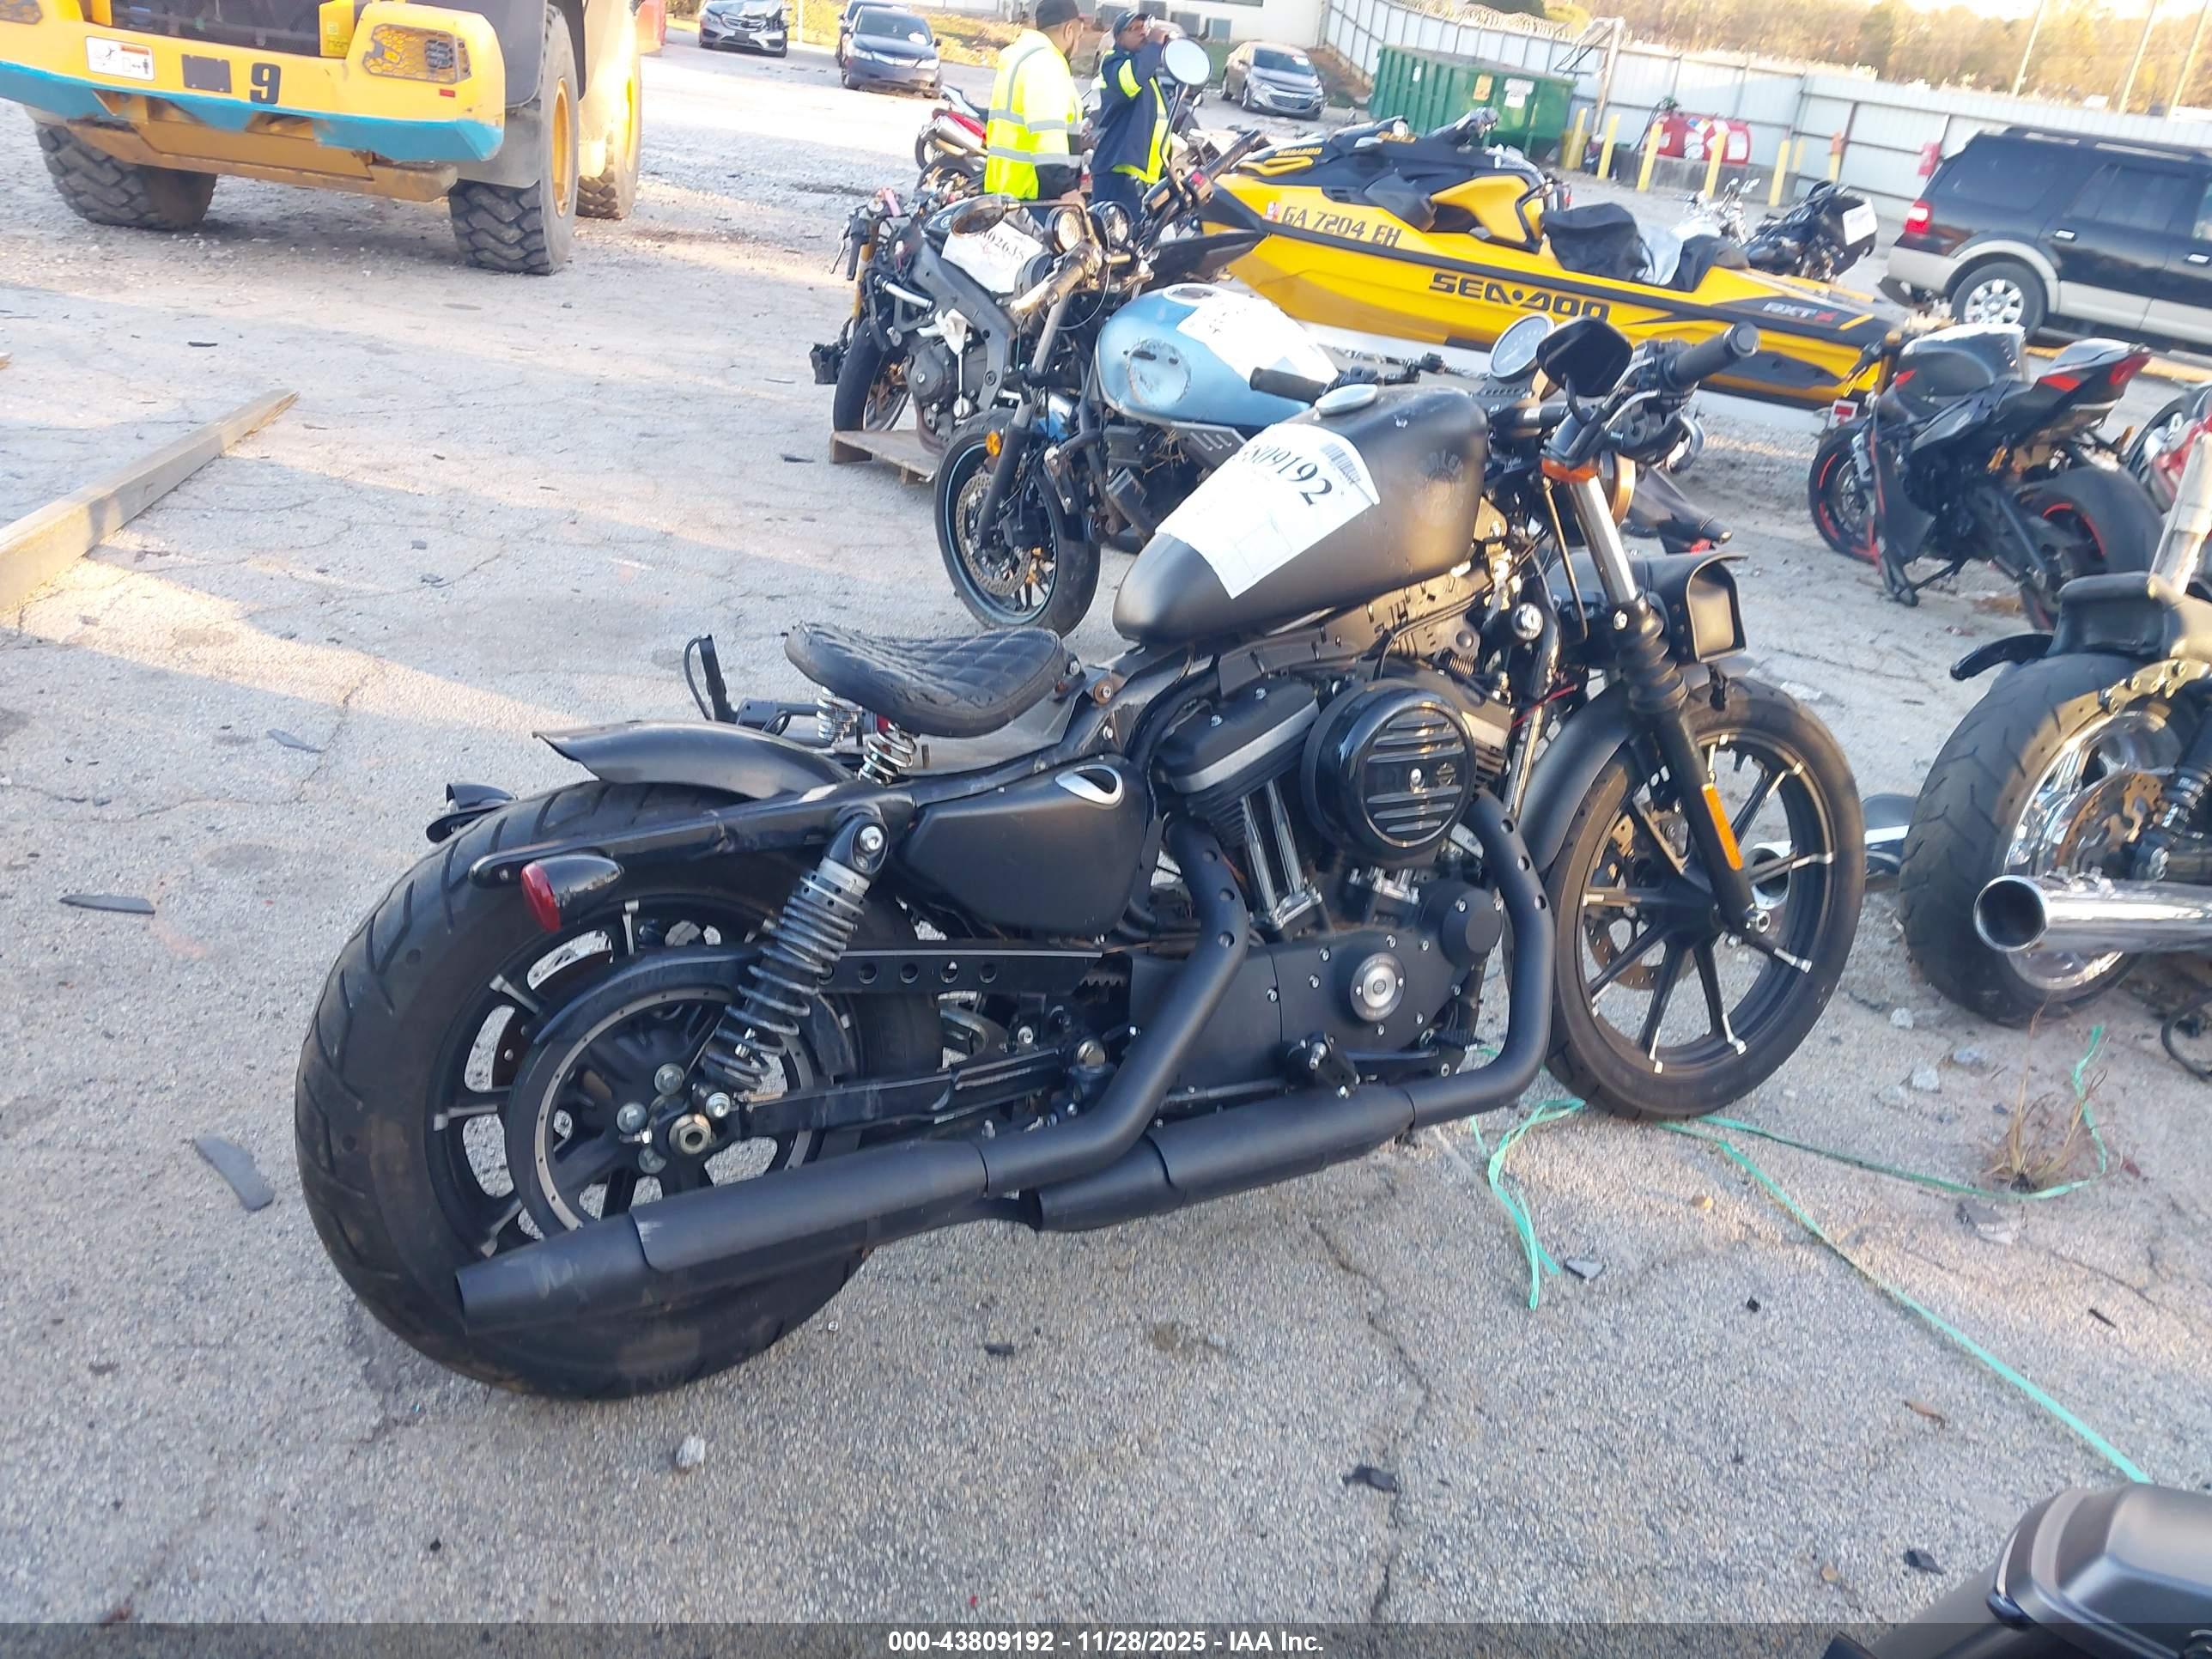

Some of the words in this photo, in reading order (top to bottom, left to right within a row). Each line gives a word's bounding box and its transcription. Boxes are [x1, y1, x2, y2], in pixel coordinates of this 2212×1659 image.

[250, 63, 282, 104] 9
[1280, 206, 1311, 228] GA
[1311, 211, 1368, 239] 7204
[1372, 224, 1403, 247] EH
